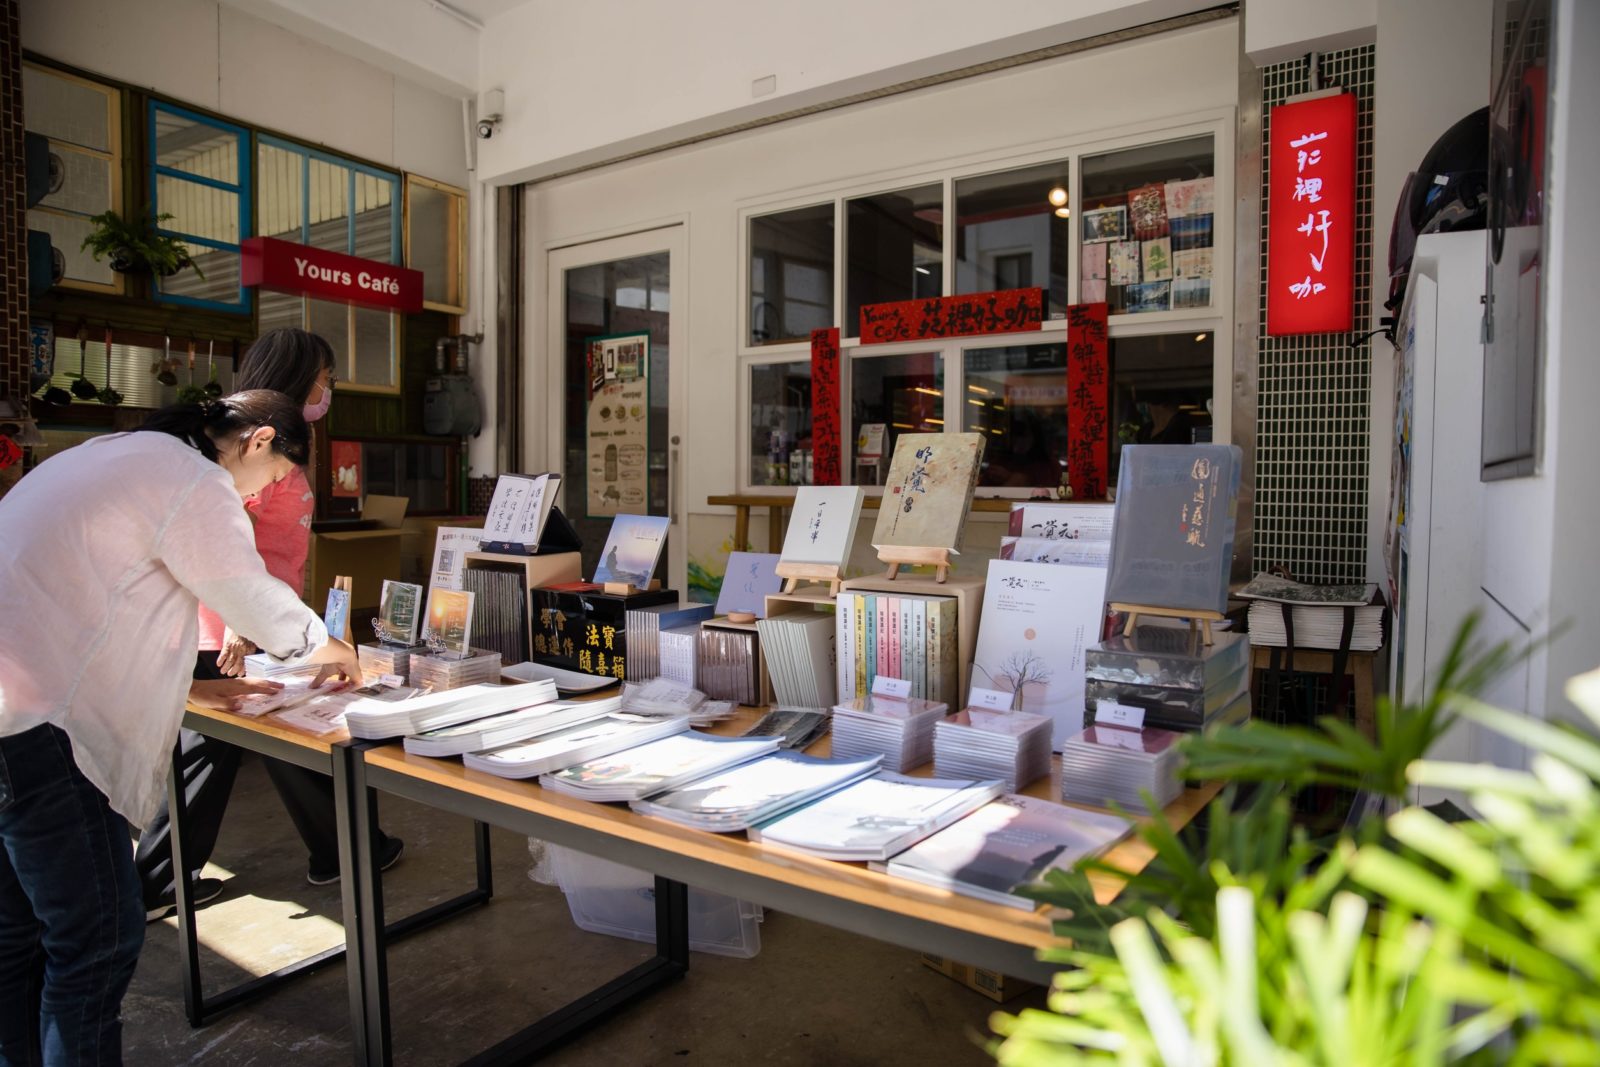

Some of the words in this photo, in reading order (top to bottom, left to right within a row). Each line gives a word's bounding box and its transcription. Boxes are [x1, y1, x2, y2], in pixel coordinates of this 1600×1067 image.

[294, 257, 352, 286] Yours
[357, 271, 400, 295] Café
[585, 624, 616, 650] 法寶
[579, 649, 625, 680] 隨喜箱
